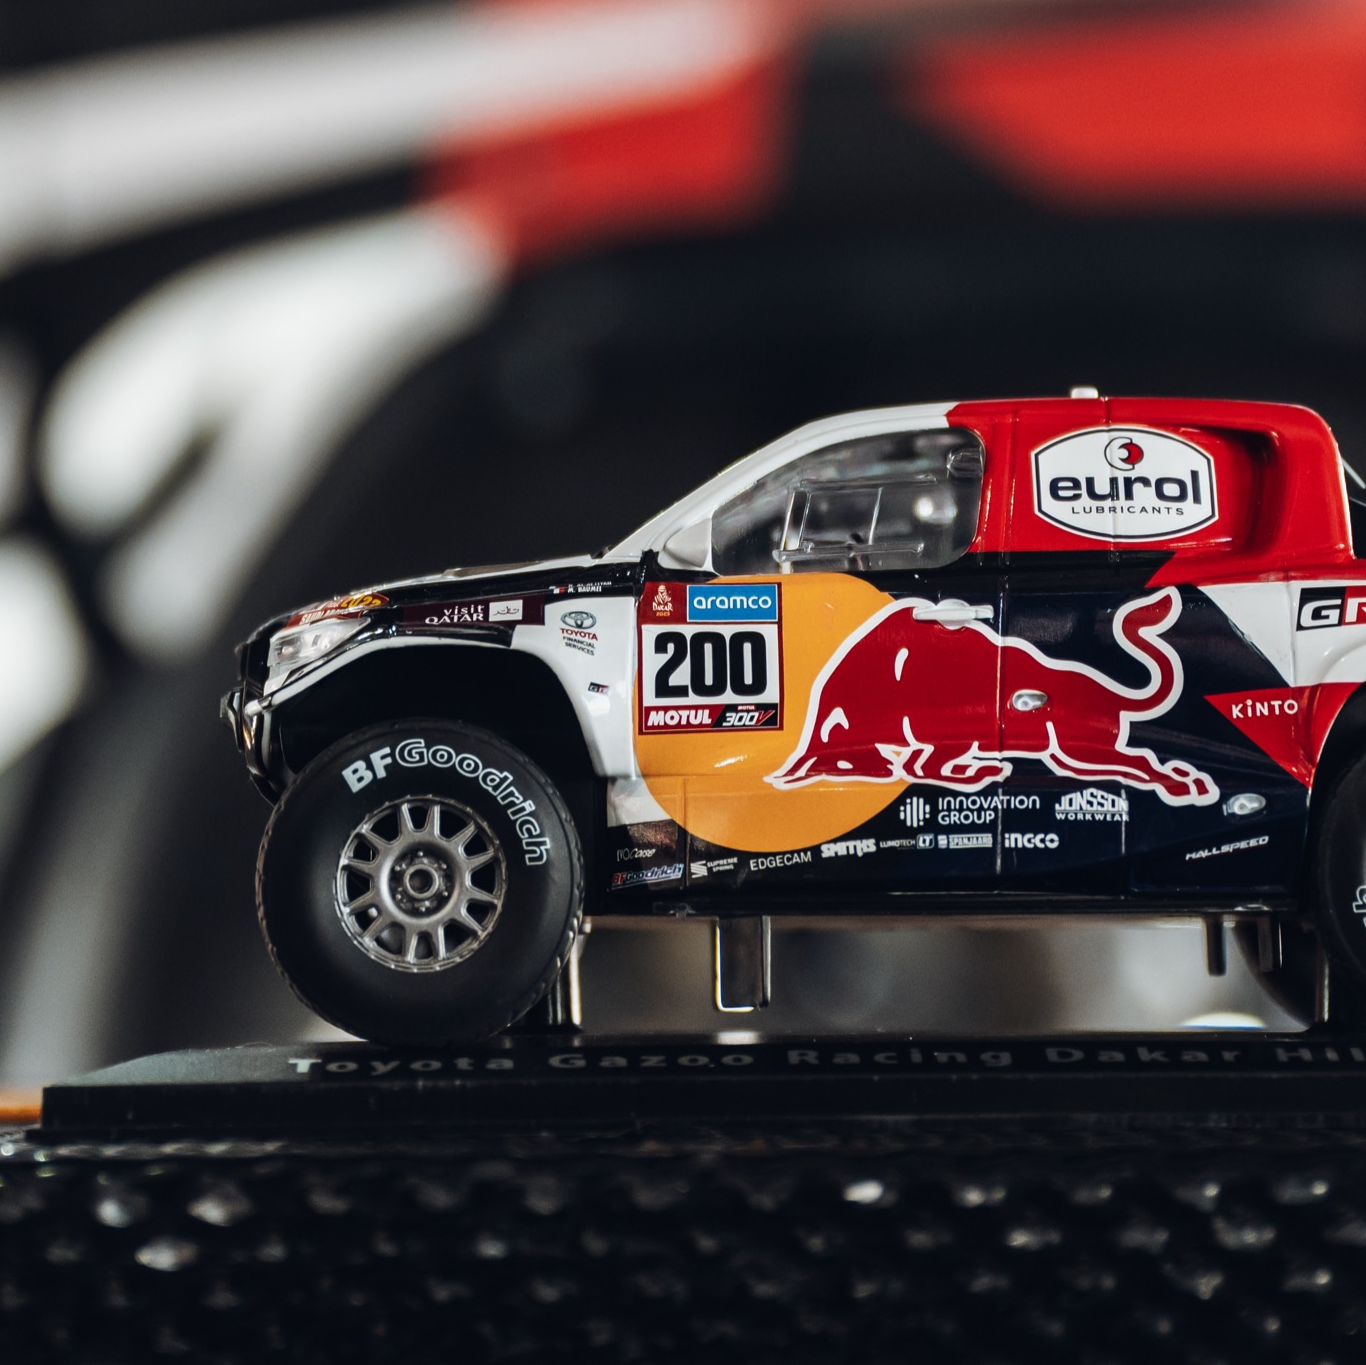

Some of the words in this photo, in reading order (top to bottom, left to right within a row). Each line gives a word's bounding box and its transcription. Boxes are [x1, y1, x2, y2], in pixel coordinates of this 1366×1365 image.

[1049, 469, 1202, 505] eurol
[1071, 505, 1184, 516] LUBRICANTS
[443, 604, 485, 615] visit
[693, 595, 772, 610] aramco
[424, 613, 484, 625] QATAR
[559, 627, 598, 641] TOYOTA
[562, 636, 595, 648] FINANCIAL
[565, 641, 595, 656] SERVICES
[654, 630, 767, 699] 200
[647, 708, 712, 726] MOTUL
[722, 710, 776, 726] 300V
[341, 738, 551, 866] BFGoodrich
[1055, 787, 1129, 811] JONSSON
[937, 811, 996, 825] GROUP
[1055, 812, 1129, 822] WORKWEAR
[820, 838, 877, 858] SMITHS
[949, 835, 993, 846] SPANJAARD
[1185, 835, 1270, 861] HALLSPEED
[707, 856, 738, 868] SUPREME
[749, 851, 812, 871] EDGECAM
[612, 863, 685, 885] BFGoodrich
[288, 1058, 515, 1076] Toyota
[547, 1049, 756, 1069] Gazoo
[787, 1047, 1013, 1072] Racing
[1045, 1047, 1241, 1065] Dakar
